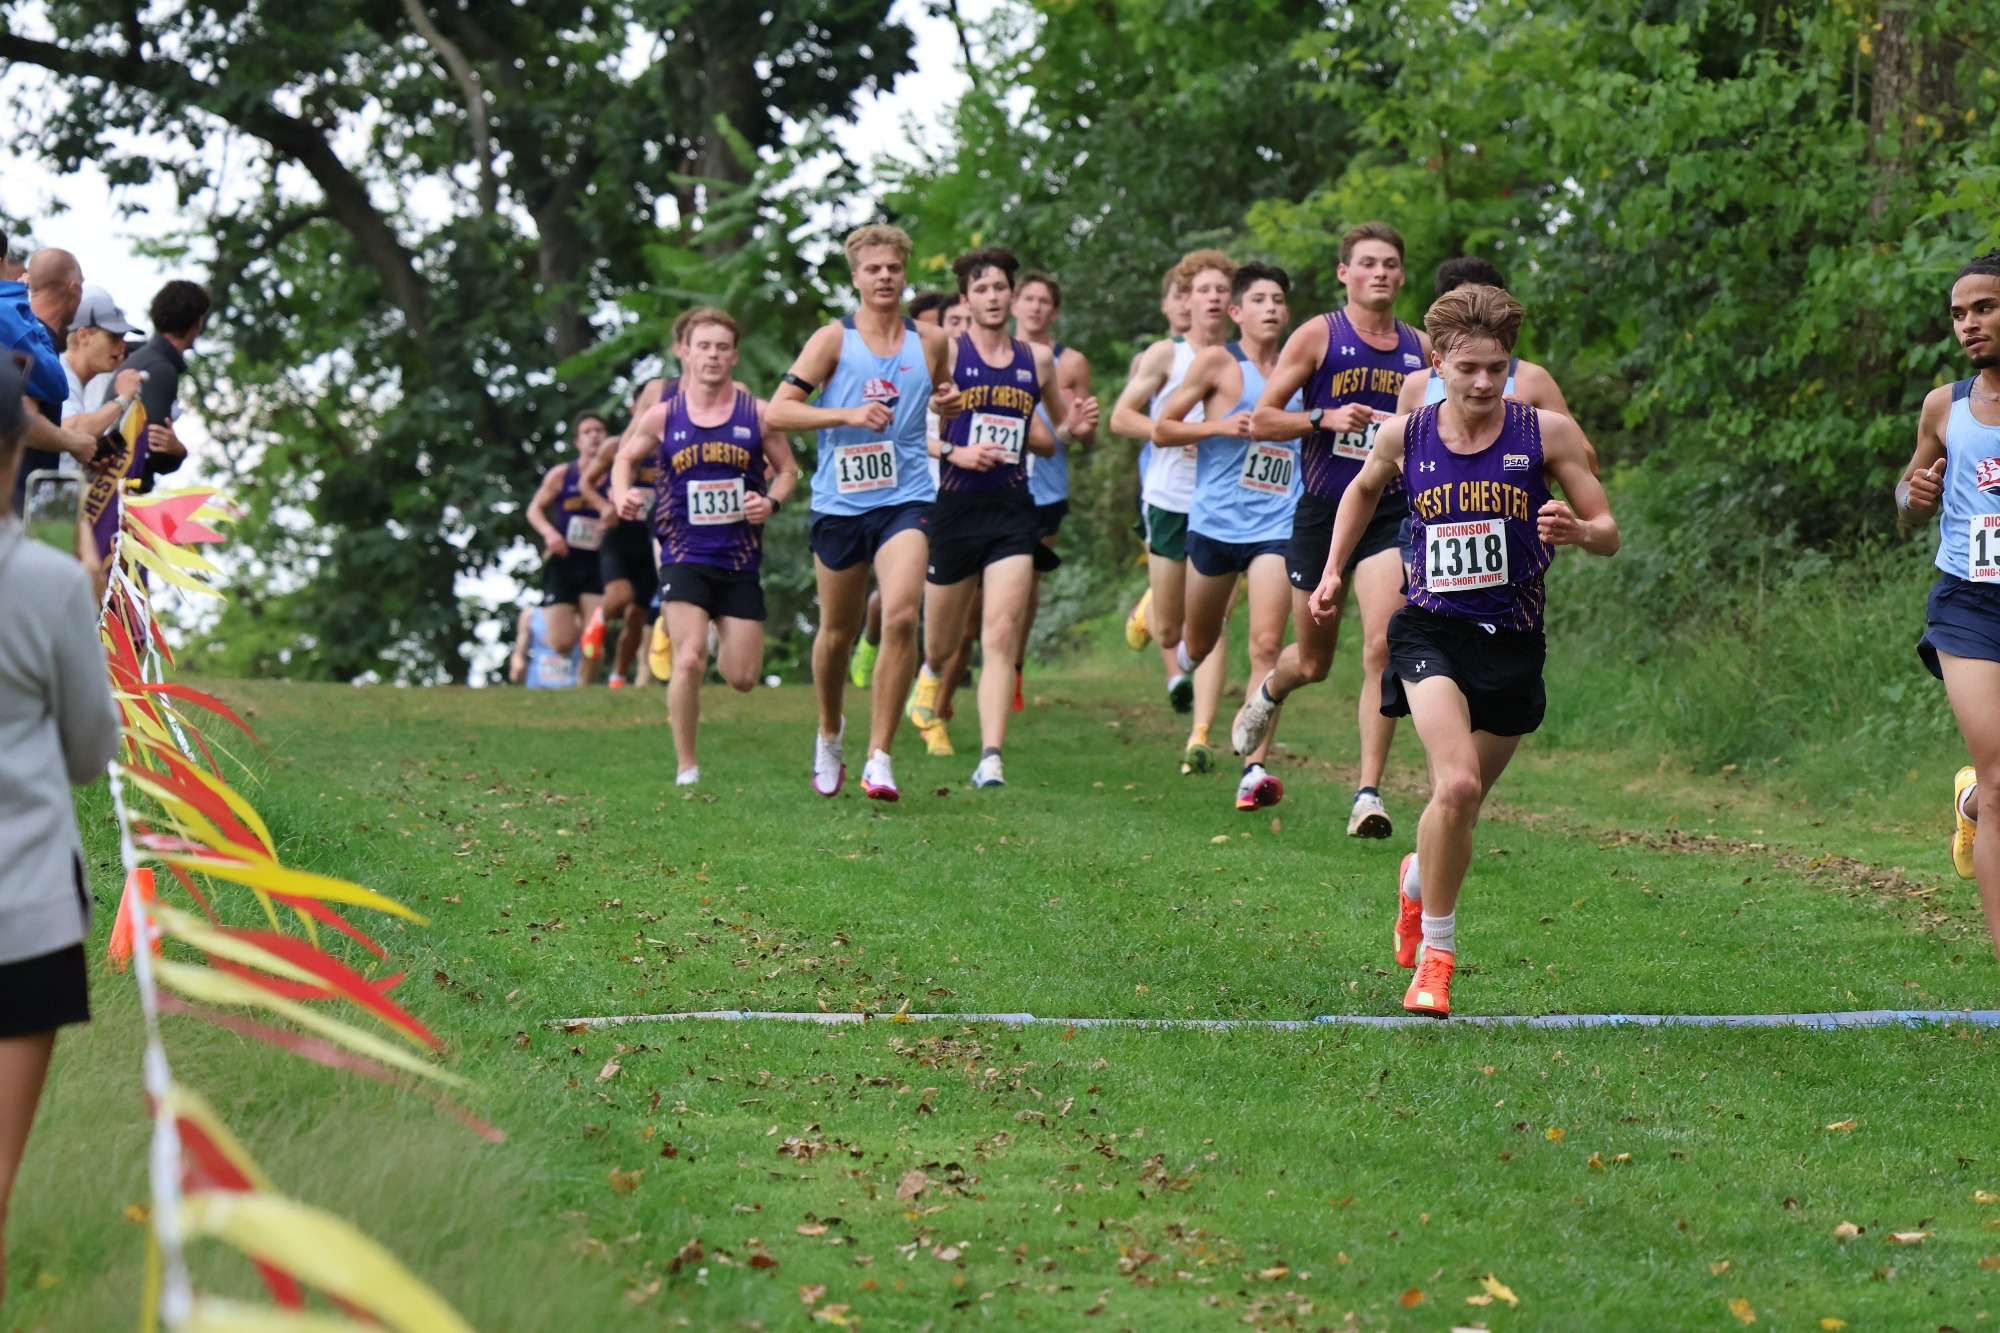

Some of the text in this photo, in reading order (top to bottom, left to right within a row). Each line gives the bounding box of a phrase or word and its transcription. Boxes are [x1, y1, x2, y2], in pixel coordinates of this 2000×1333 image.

[1331, 367, 1406, 398] WEST CHES
[960, 384, 1034, 415] WEST CHESTER
[975, 424, 1019, 452] 1321
[672, 441, 750, 474] WEST CHESTER
[840, 452, 893, 482] 1308
[1245, 453, 1292, 486] 1300
[1504, 458, 1528, 467] PSAC
[693, 489, 740, 514] 1331
[1414, 481, 1529, 521] WEST CHESTER
[1437, 522, 1491, 538] DICKINSON
[1430, 534, 1503, 577] 1318
[1432, 573, 1503, 587] LONG-SHORT INVITE
